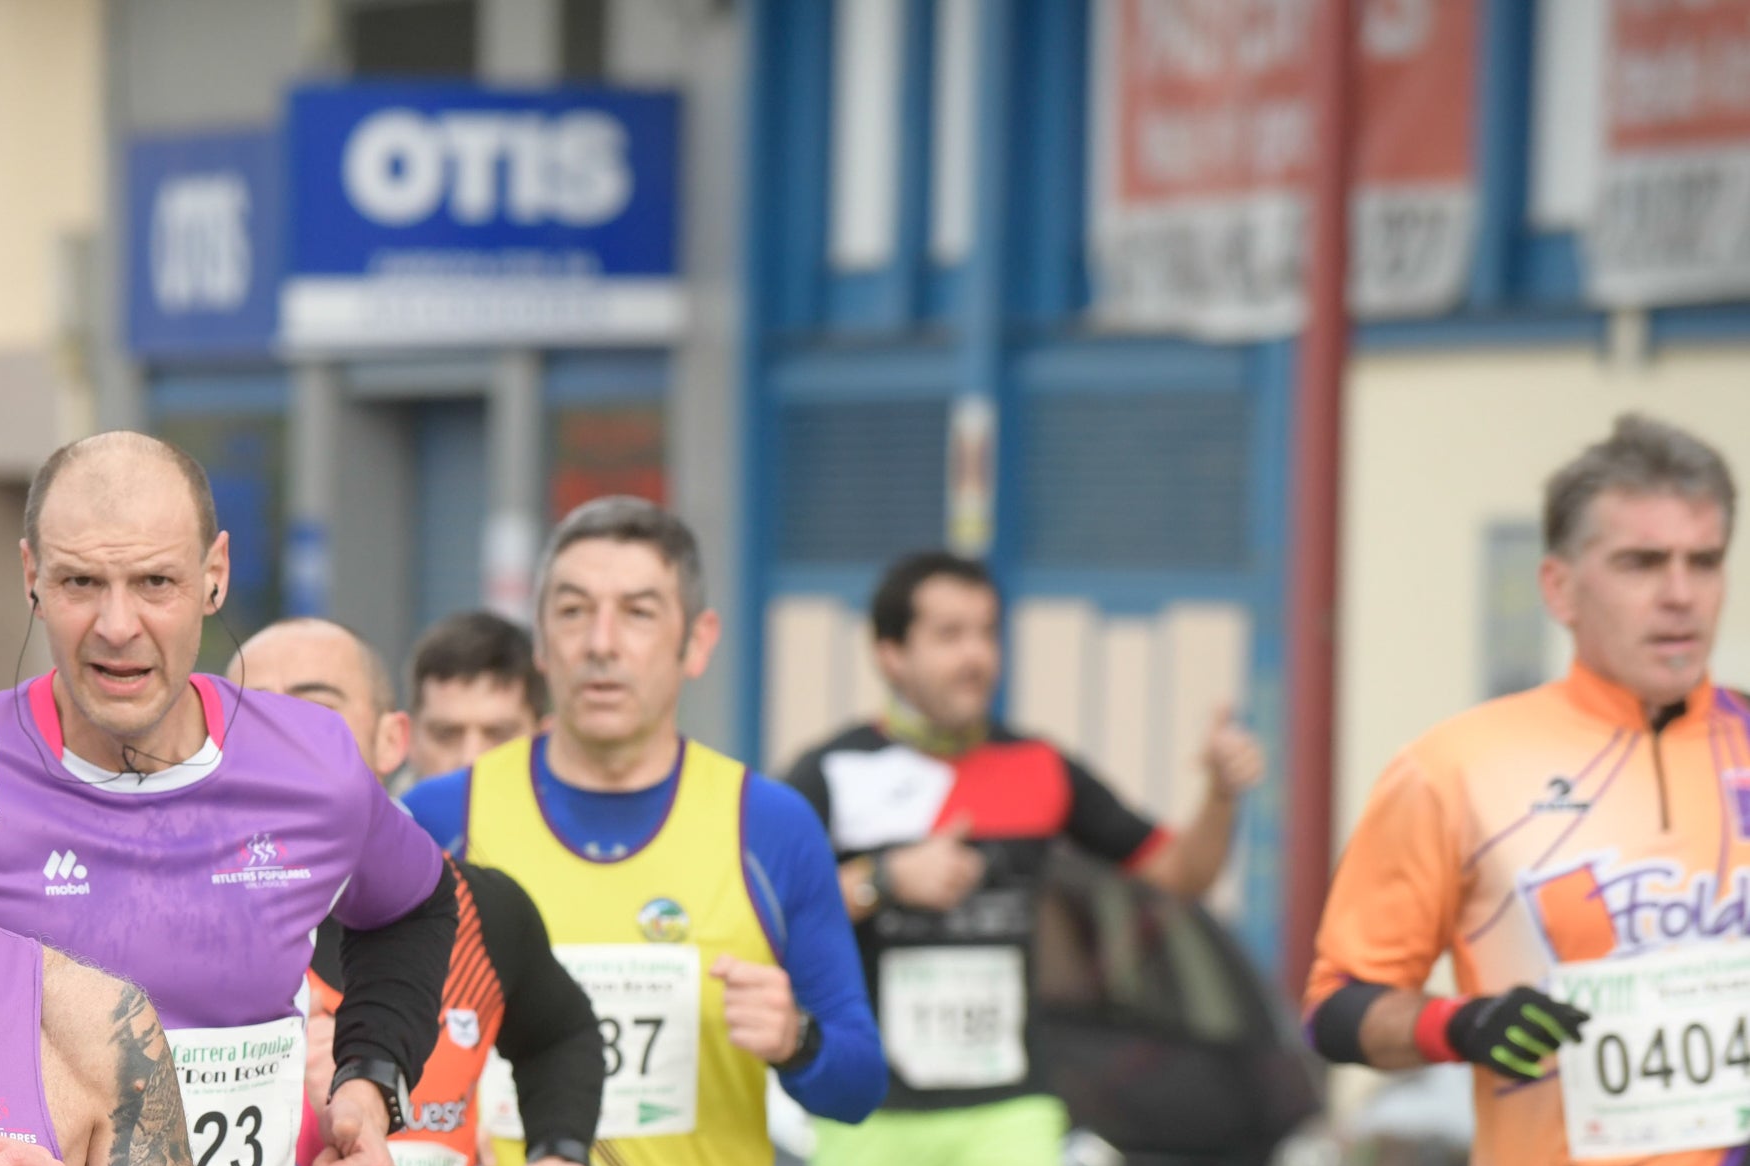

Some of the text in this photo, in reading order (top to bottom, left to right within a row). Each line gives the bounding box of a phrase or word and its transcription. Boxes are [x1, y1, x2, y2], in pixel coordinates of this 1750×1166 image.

[343, 108, 634, 228] OTIS
[45, 882, 90, 896] mobel
[211, 869, 311, 884] ATLETAS POPULARES
[172, 1035, 295, 1063] Carrera Popular
[1597, 1015, 1750, 1095] 0404
